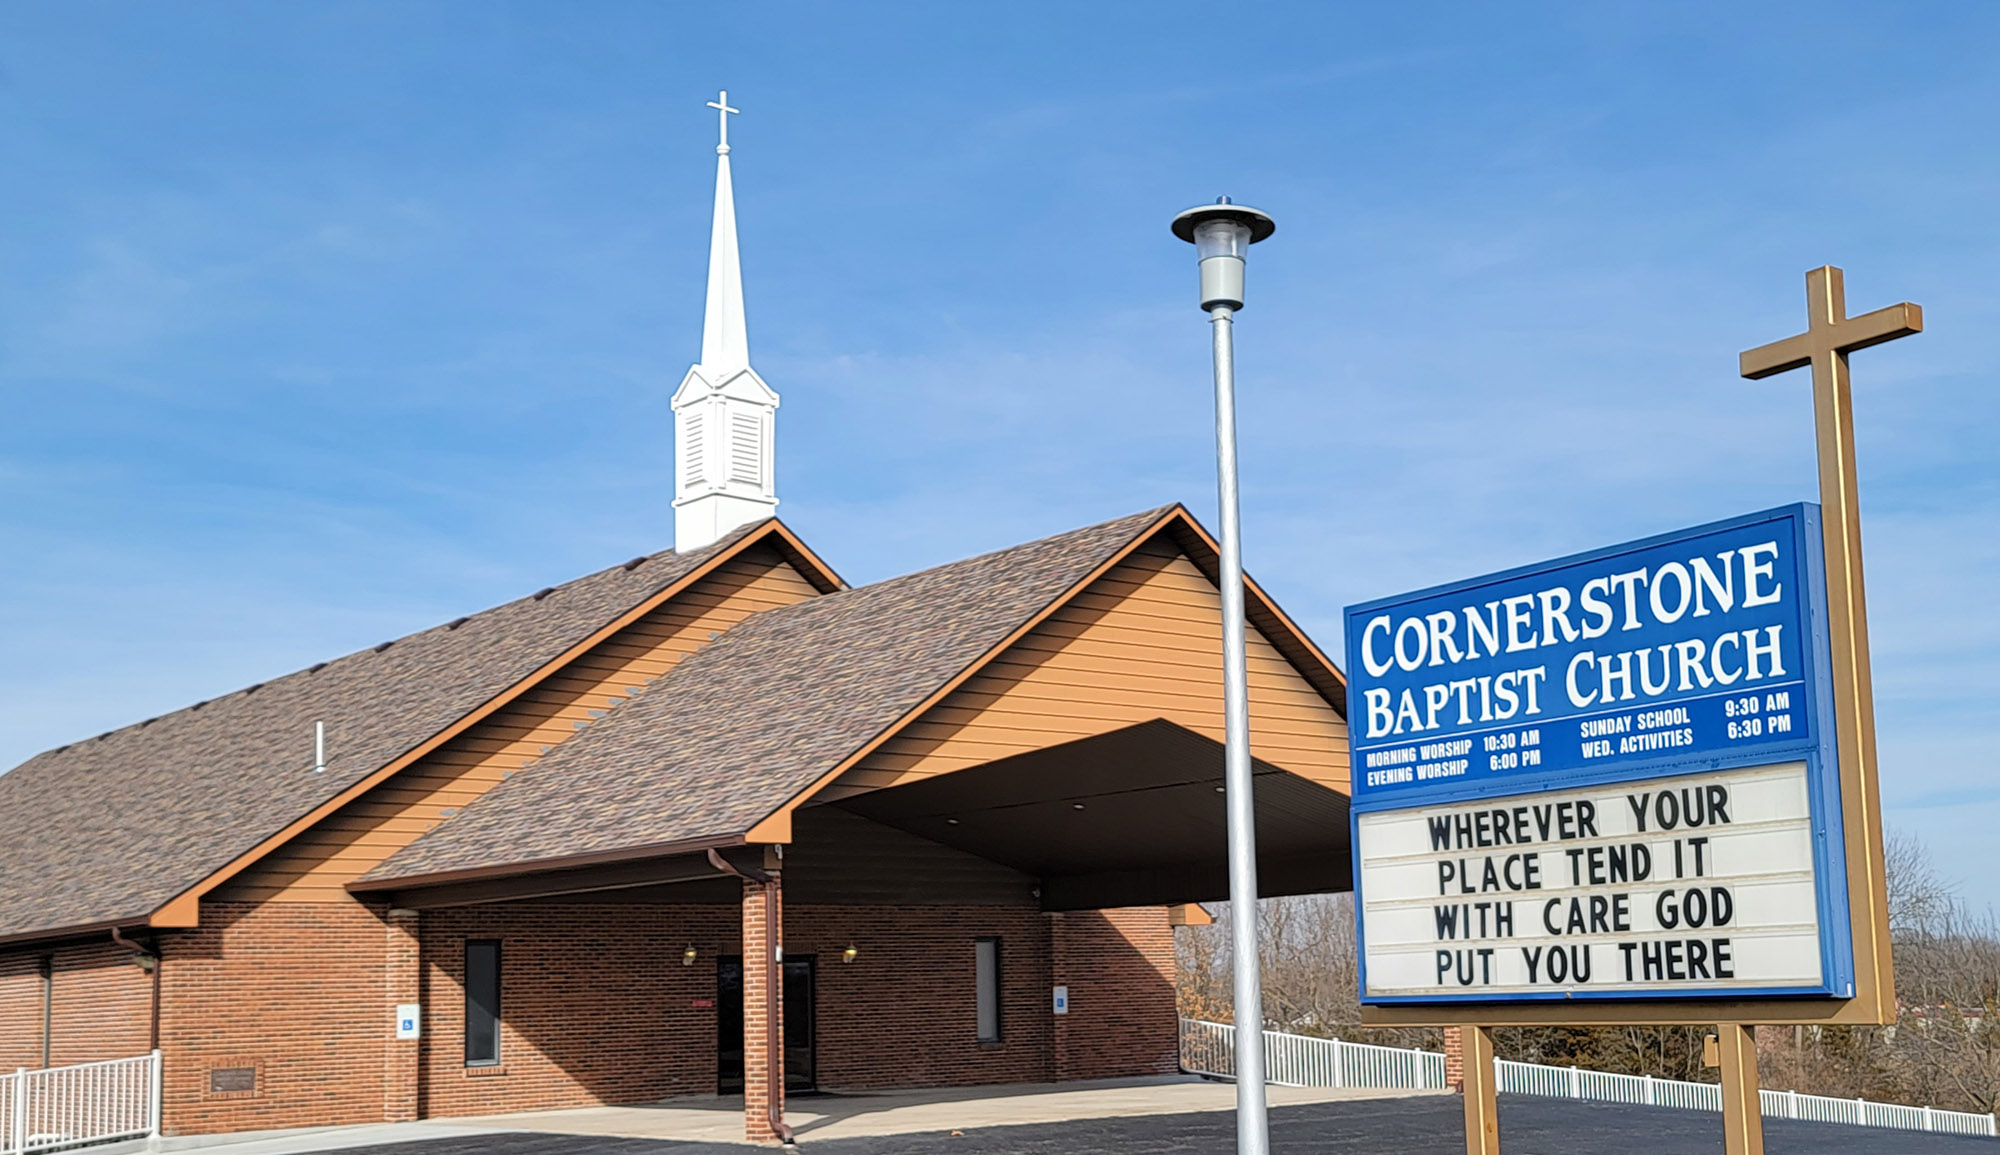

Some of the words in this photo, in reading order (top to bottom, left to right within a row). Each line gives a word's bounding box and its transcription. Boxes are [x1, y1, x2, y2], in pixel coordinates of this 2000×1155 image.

[1361, 541, 1782, 678] CORNERSTONE
[1364, 666, 1546, 739] BAPTIST
[1565, 625, 1786, 709] CHURCH
[1580, 715, 1632, 738] SUNDAY
[1637, 707, 1690, 730] SCHOOL
[1725, 696, 1759, 717] 9:30
[1766, 692, 1790, 712] AM
[1581, 740, 1614, 759] WED.
[1620, 728, 1693, 754] ACTIVITIES
[1727, 718, 1761, 739] 6:30
[1768, 714, 1791, 734] PM
[1366, 747, 1417, 768] MORNING
[1420, 739, 1472, 761] WORSHIP
[1483, 733, 1516, 752] 10:30
[1520, 729, 1540, 747] AM
[1367, 766, 1413, 787] EVENING
[1416, 759, 1468, 780] WORSHIP
[1490, 752, 1517, 771] 6:00
[1522, 749, 1541, 767] PM
[1428, 800, 1598, 851] WHEREVER
[1628, 784, 1731, 832] YOUR
[1439, 852, 1541, 895] PLACE
[1565, 843, 1651, 886] TEND
[1674, 836, 1709, 878] IT
[1434, 901, 1513, 940] WITH
[1543, 893, 1630, 935] CARE
[1656, 887, 1733, 929] GOD
[1437, 948, 1494, 985] PUT
[1522, 944, 1591, 983] YOU
[1619, 938, 1734, 982] THERE
